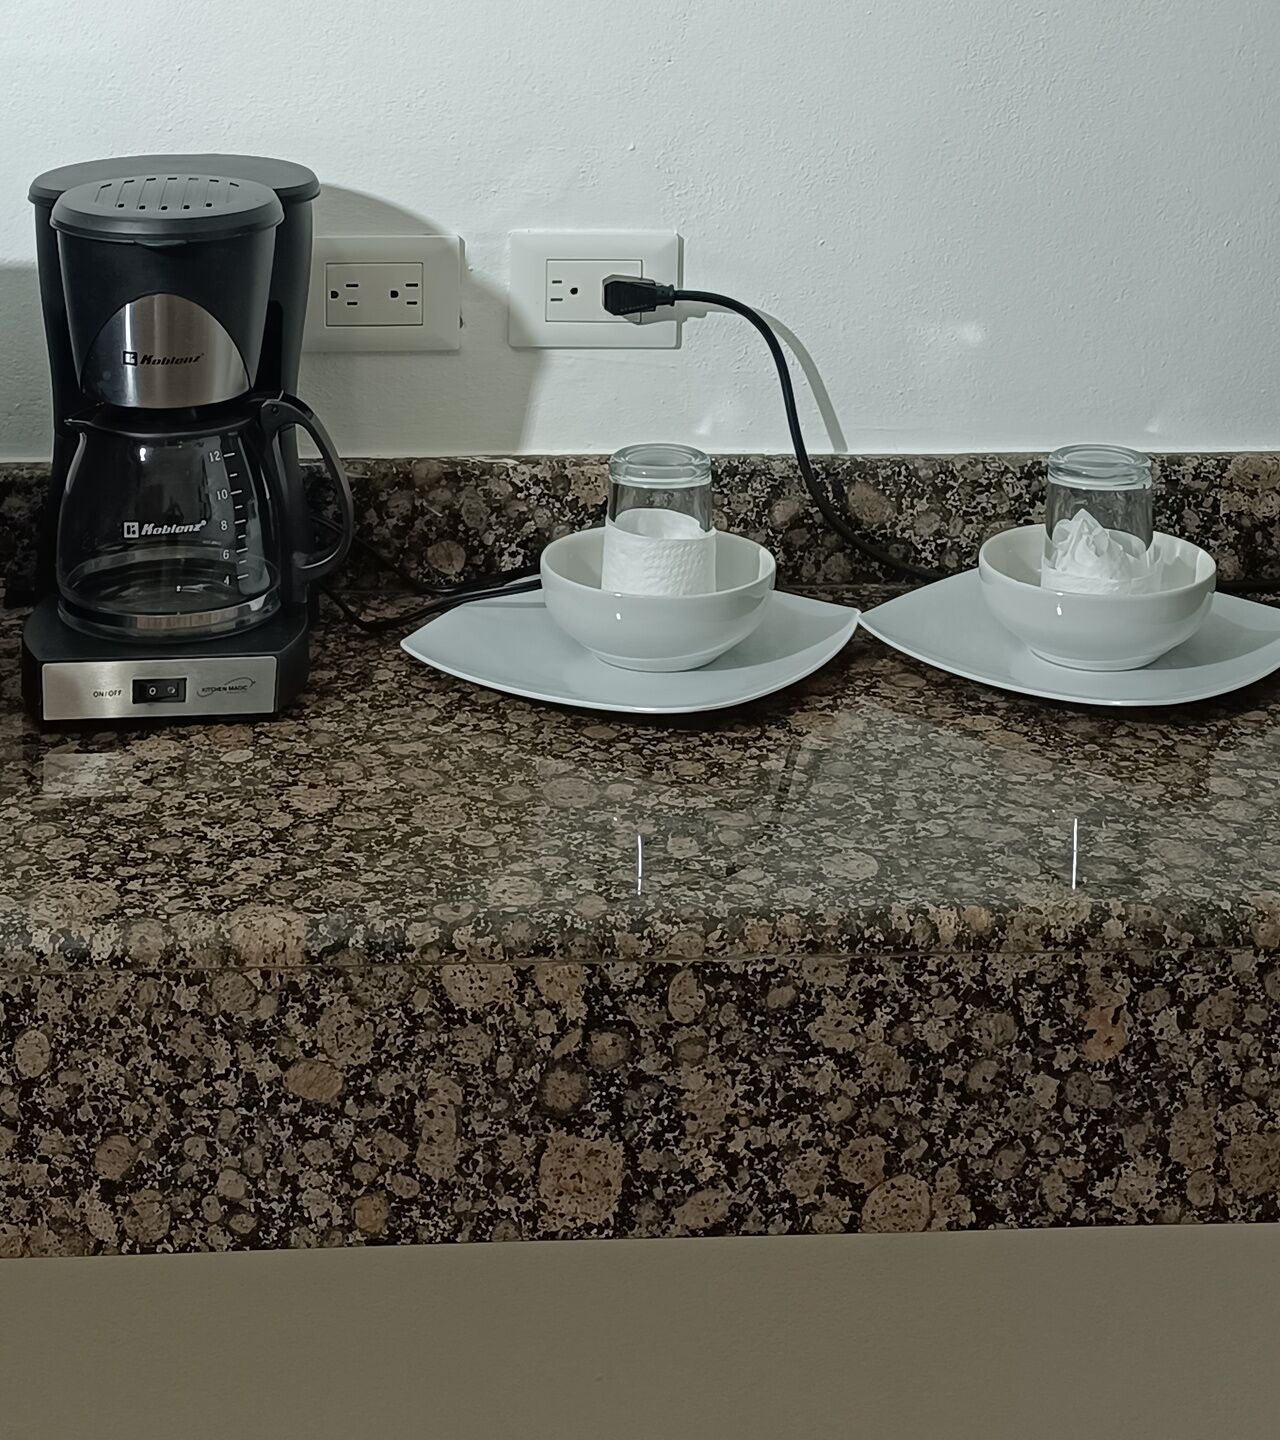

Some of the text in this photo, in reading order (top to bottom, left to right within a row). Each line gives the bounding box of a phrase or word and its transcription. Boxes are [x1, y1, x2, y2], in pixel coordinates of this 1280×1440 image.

[140, 354, 201, 366] Koblenz
[209, 451, 221, 462] 12
[217, 489, 228, 500] 10
[141, 522, 202, 535] Koblenz
[221, 520, 228, 531] 8
[223, 549, 230, 560] 6
